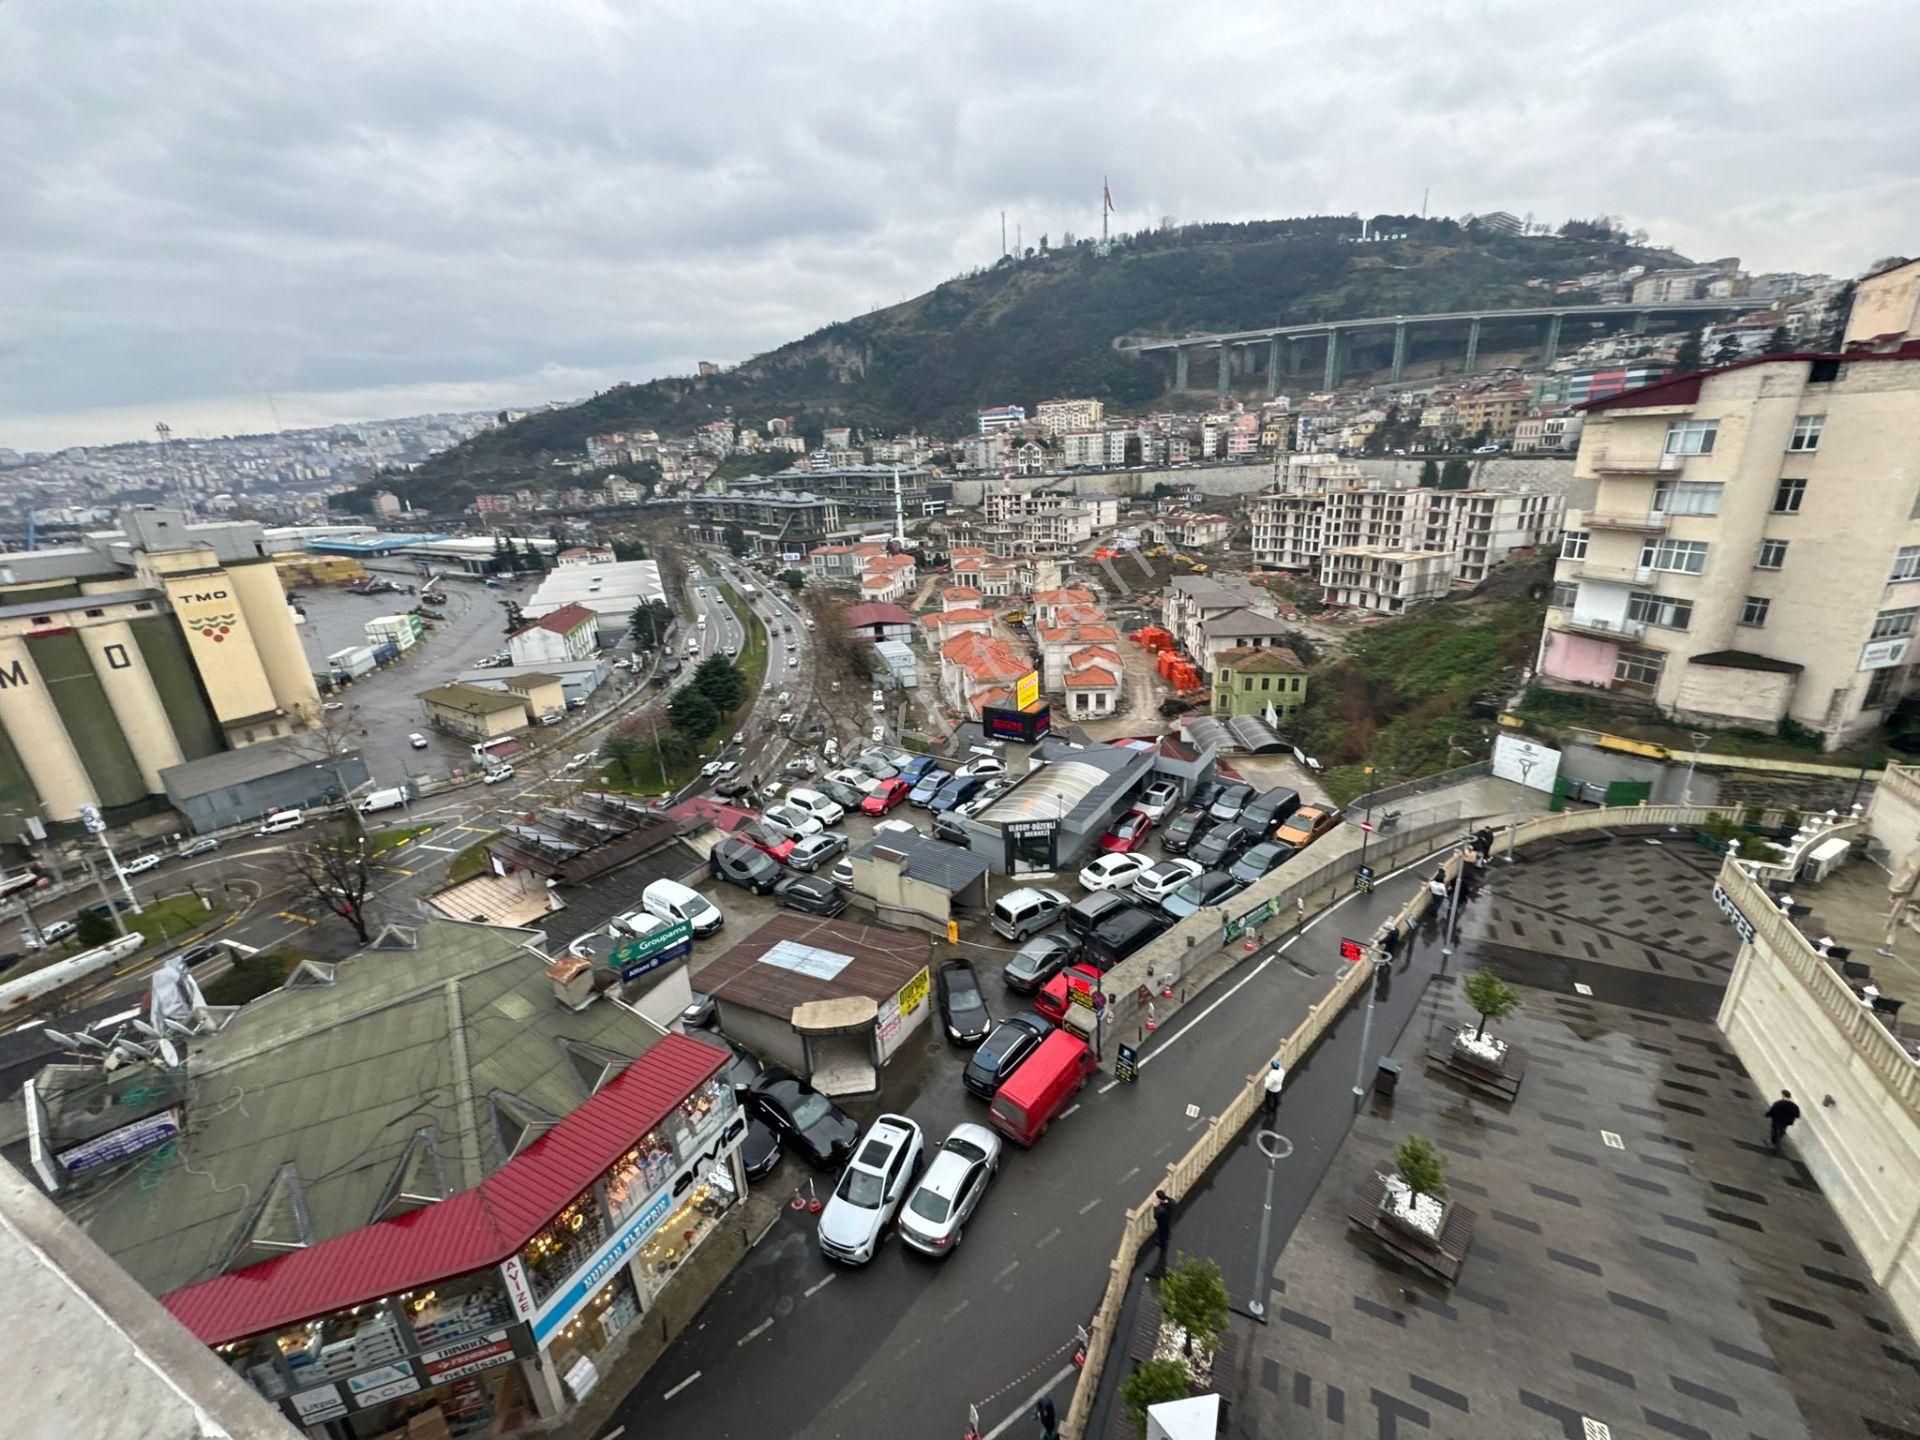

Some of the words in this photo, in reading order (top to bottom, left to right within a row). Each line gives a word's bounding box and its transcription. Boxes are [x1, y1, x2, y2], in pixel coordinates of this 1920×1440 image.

[178, 590, 228, 604] TMO
[1712, 887, 1755, 943] COFFEE
[639, 925, 687, 950] Groupama
